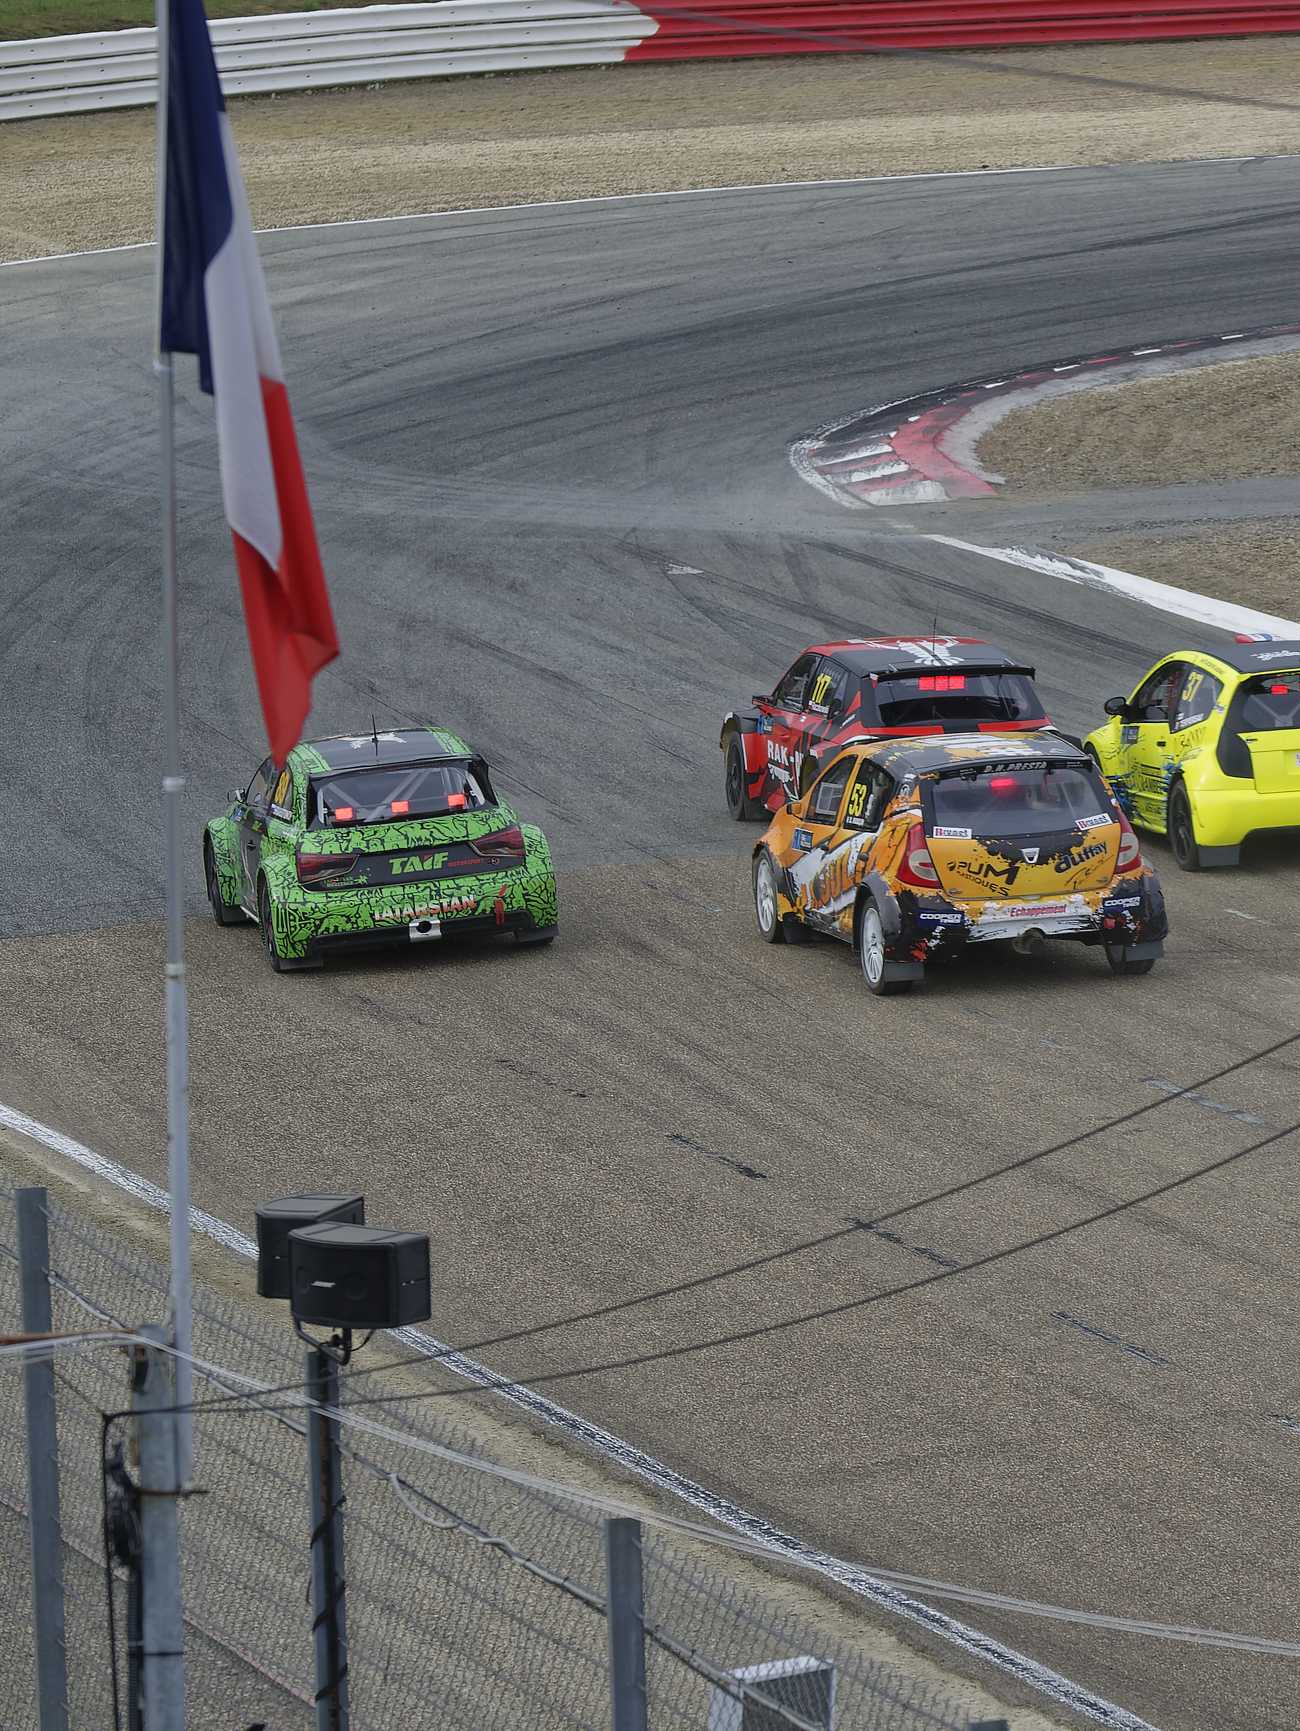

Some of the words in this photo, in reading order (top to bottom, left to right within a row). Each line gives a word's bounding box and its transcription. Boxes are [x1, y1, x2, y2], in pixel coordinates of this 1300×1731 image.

[847, 782, 868, 817] 53
[1104, 896, 1141, 907] COOPER
[919, 913, 962, 921] COOPER
